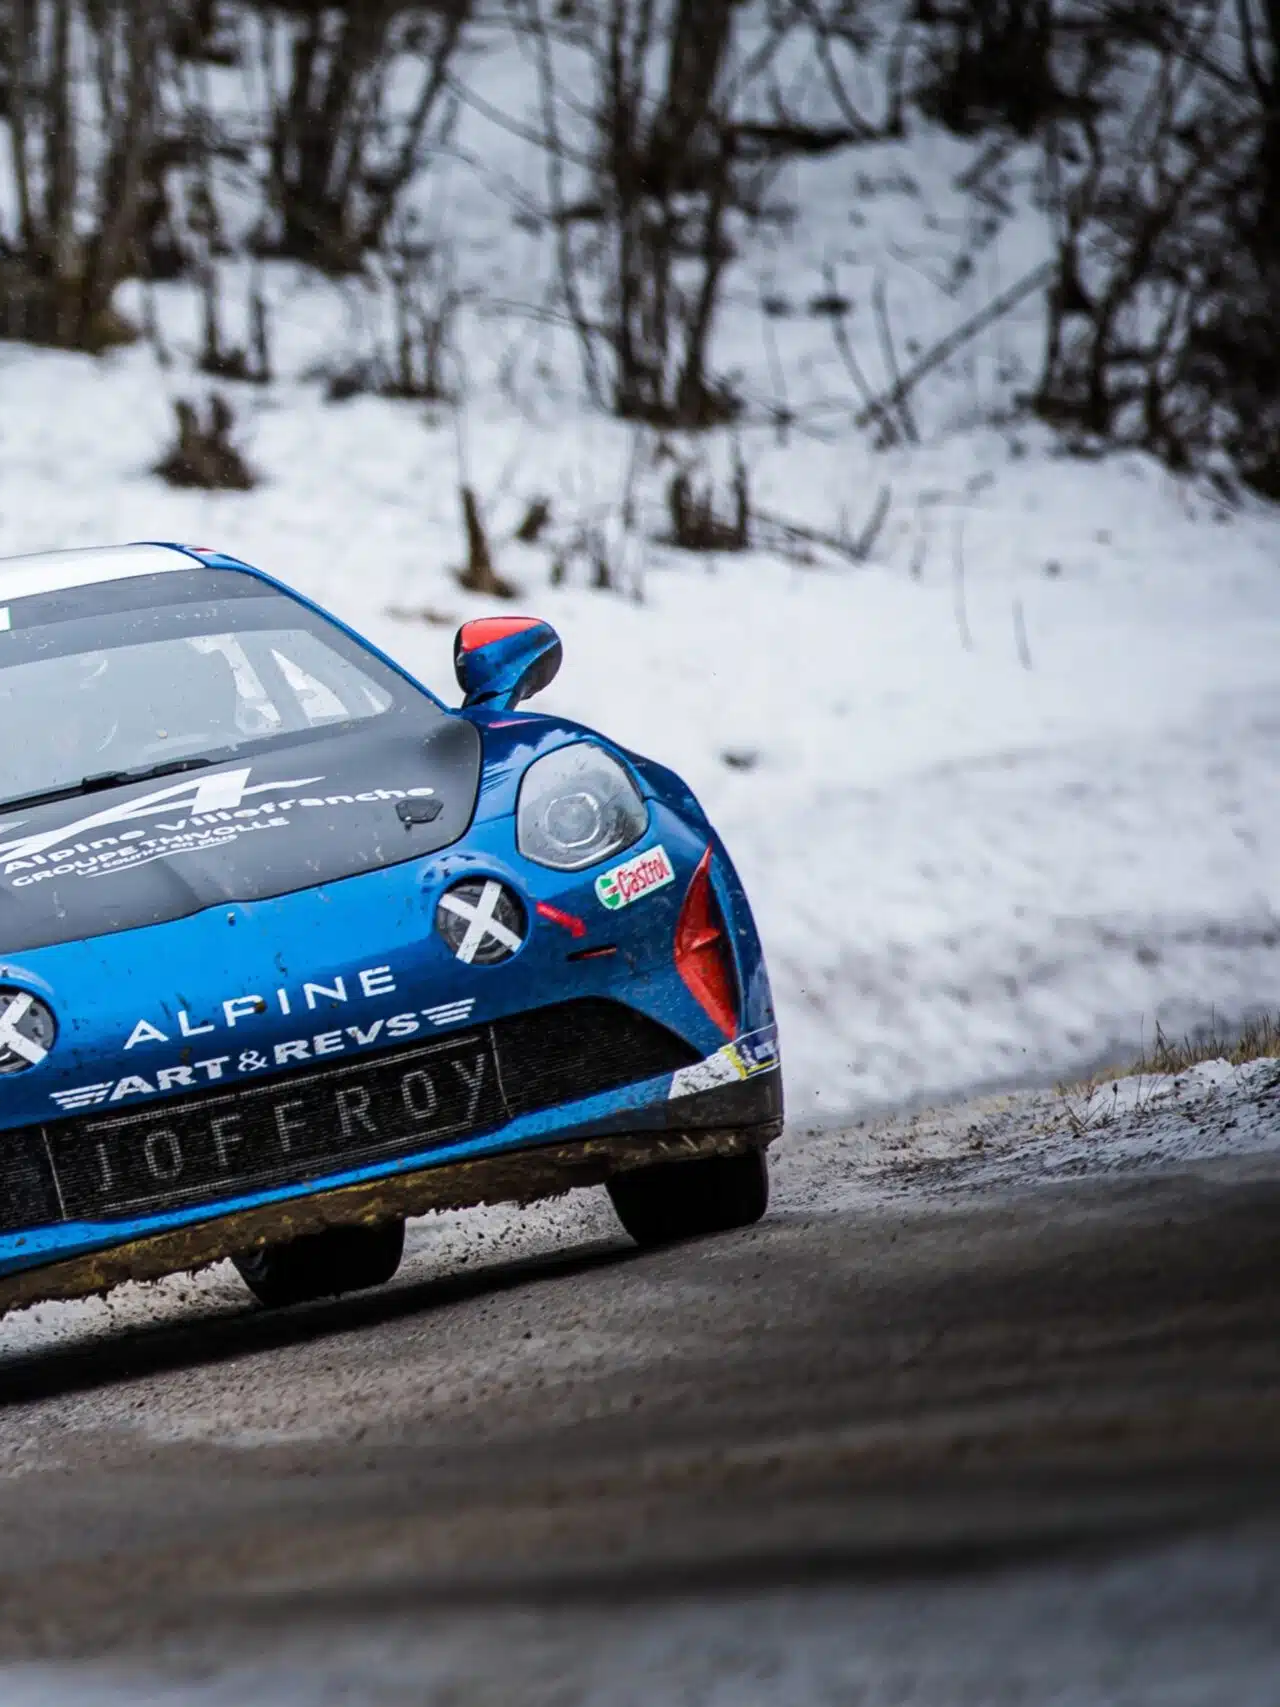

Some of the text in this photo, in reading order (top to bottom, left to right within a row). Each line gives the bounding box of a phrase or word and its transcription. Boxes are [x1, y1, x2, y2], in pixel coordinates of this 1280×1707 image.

[4, 829, 146, 876] Alpine
[154, 786, 436, 832] Villefranche
[11, 816, 290, 887] GROUPE THIVOLLE
[616, 853, 670, 898] Castrol
[123, 965, 397, 1050] ALPINE
